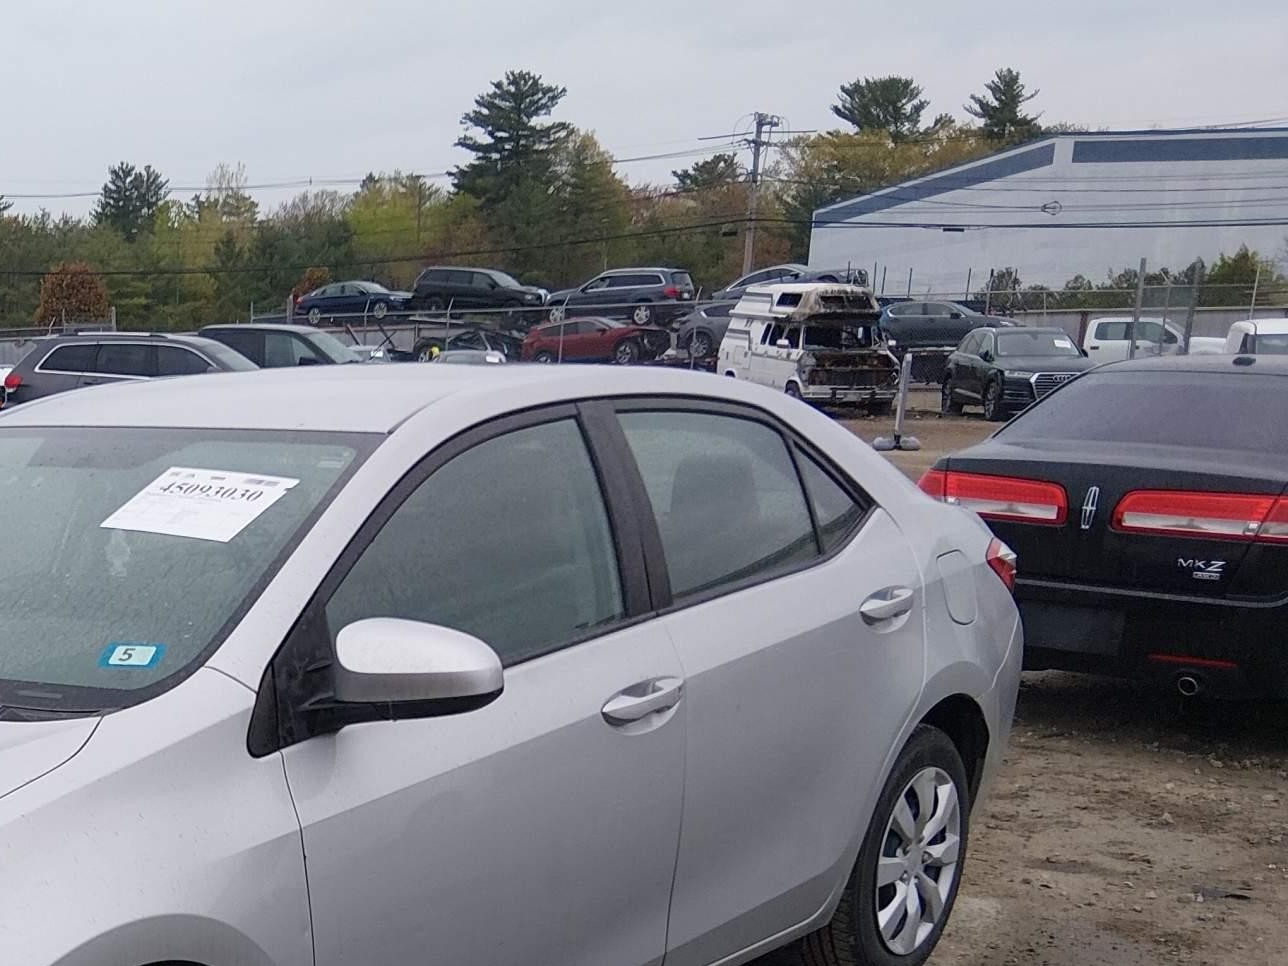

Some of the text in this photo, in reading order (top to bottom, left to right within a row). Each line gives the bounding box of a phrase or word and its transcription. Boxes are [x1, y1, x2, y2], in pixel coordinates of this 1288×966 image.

[160, 481, 264, 501] 45093030
[1177, 558, 1226, 571] MKZ
[118, 647, 136, 661] 5
